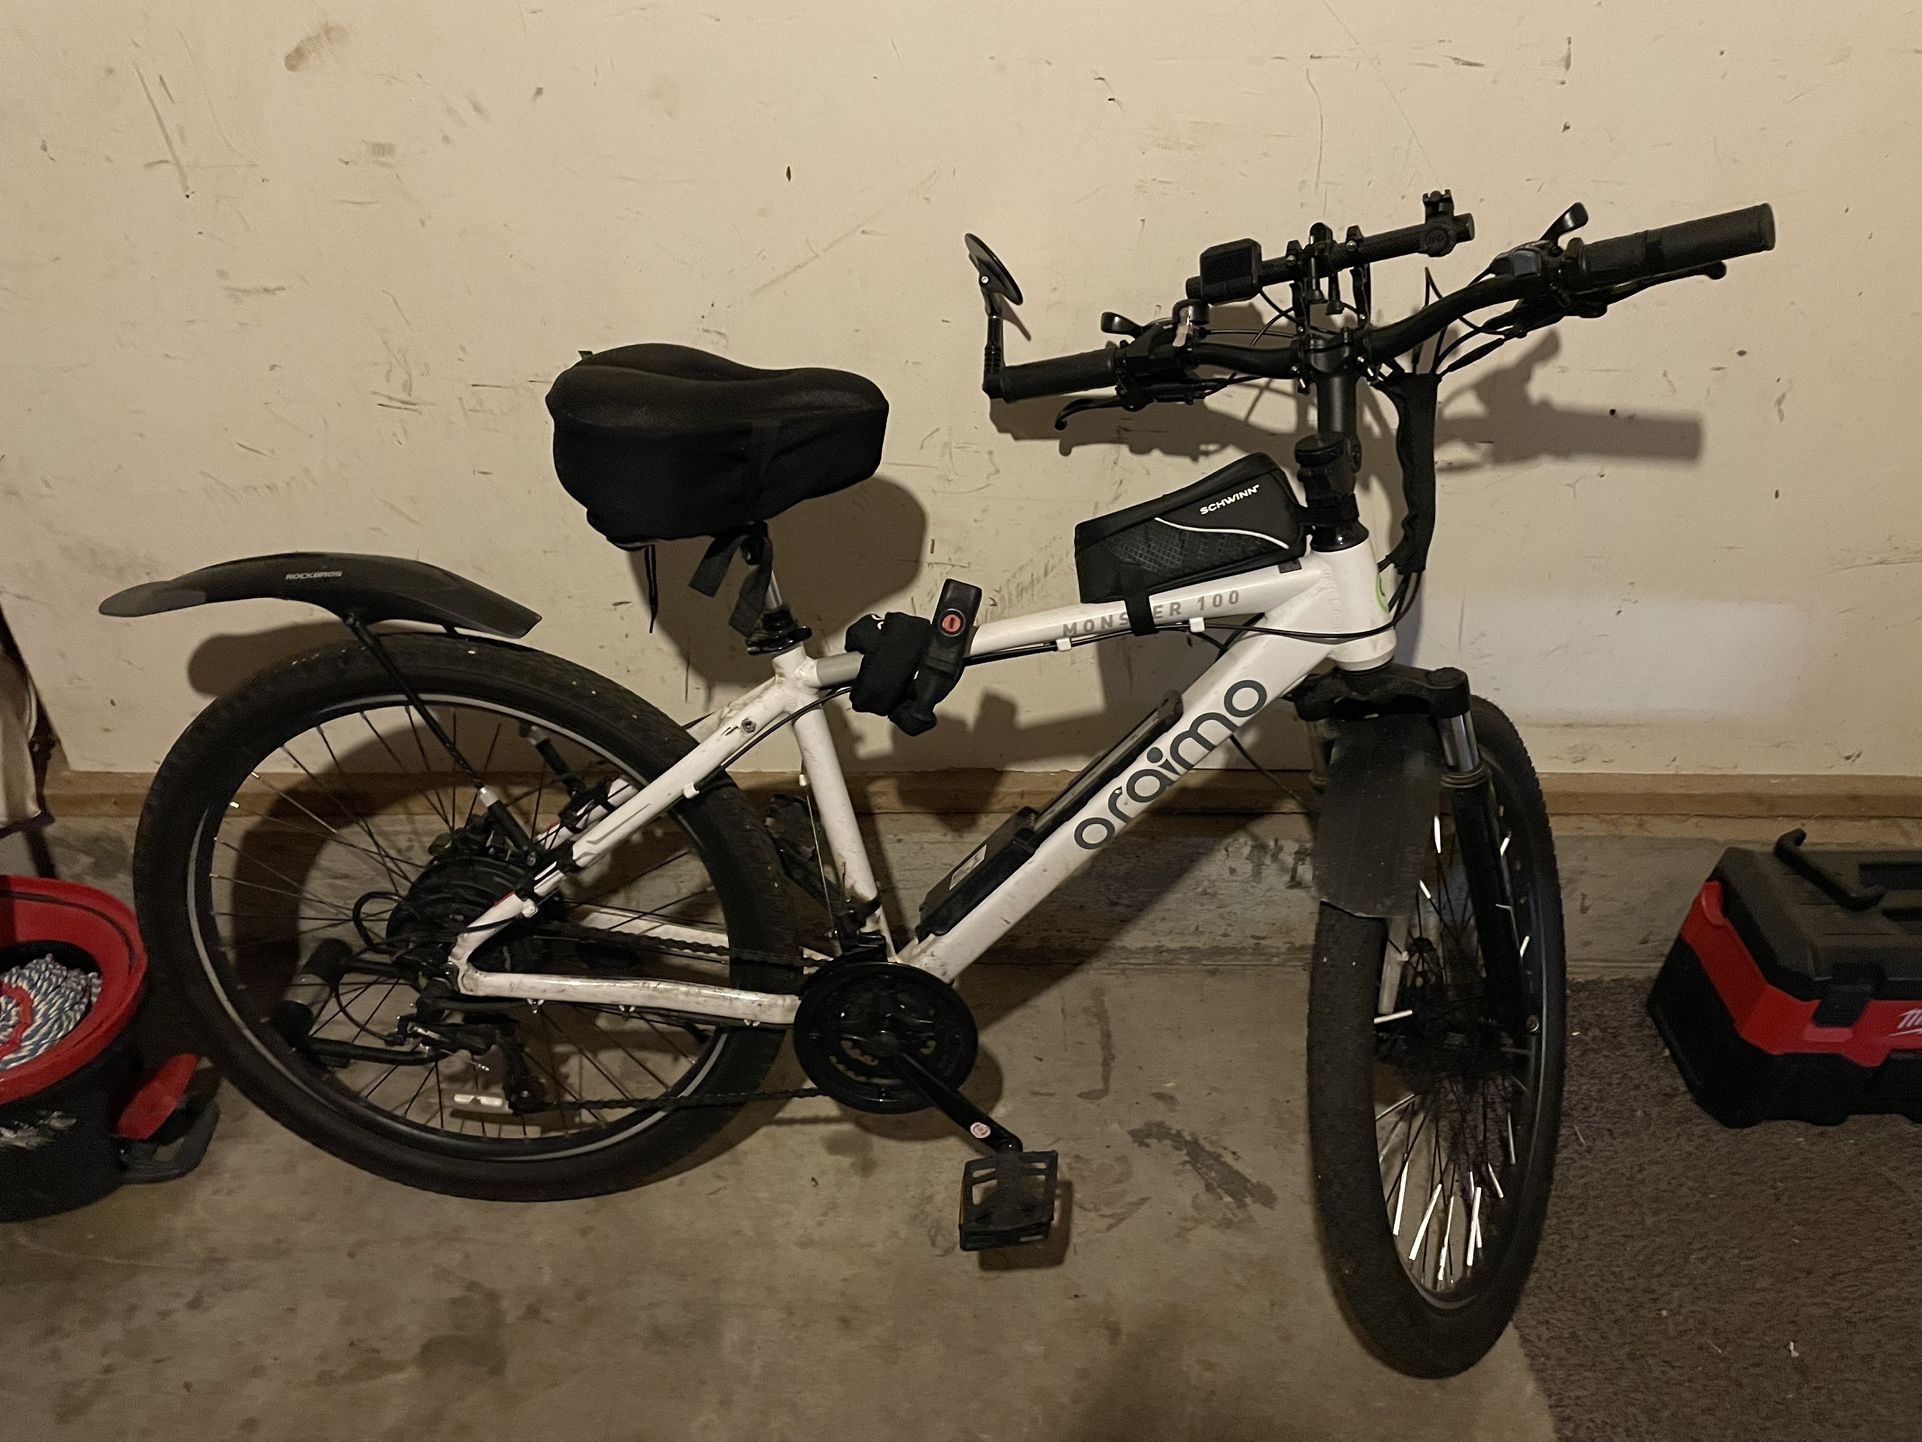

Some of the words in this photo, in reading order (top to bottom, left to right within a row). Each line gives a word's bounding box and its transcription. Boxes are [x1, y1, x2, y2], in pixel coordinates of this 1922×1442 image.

[1199, 484, 1260, 515] SCHWINN
[285, 570, 343, 581] ROCKBROS
[1062, 601, 1182, 638] MONSER
[1197, 589, 1240, 611] 100
[1073, 679, 1268, 850] oraimo
